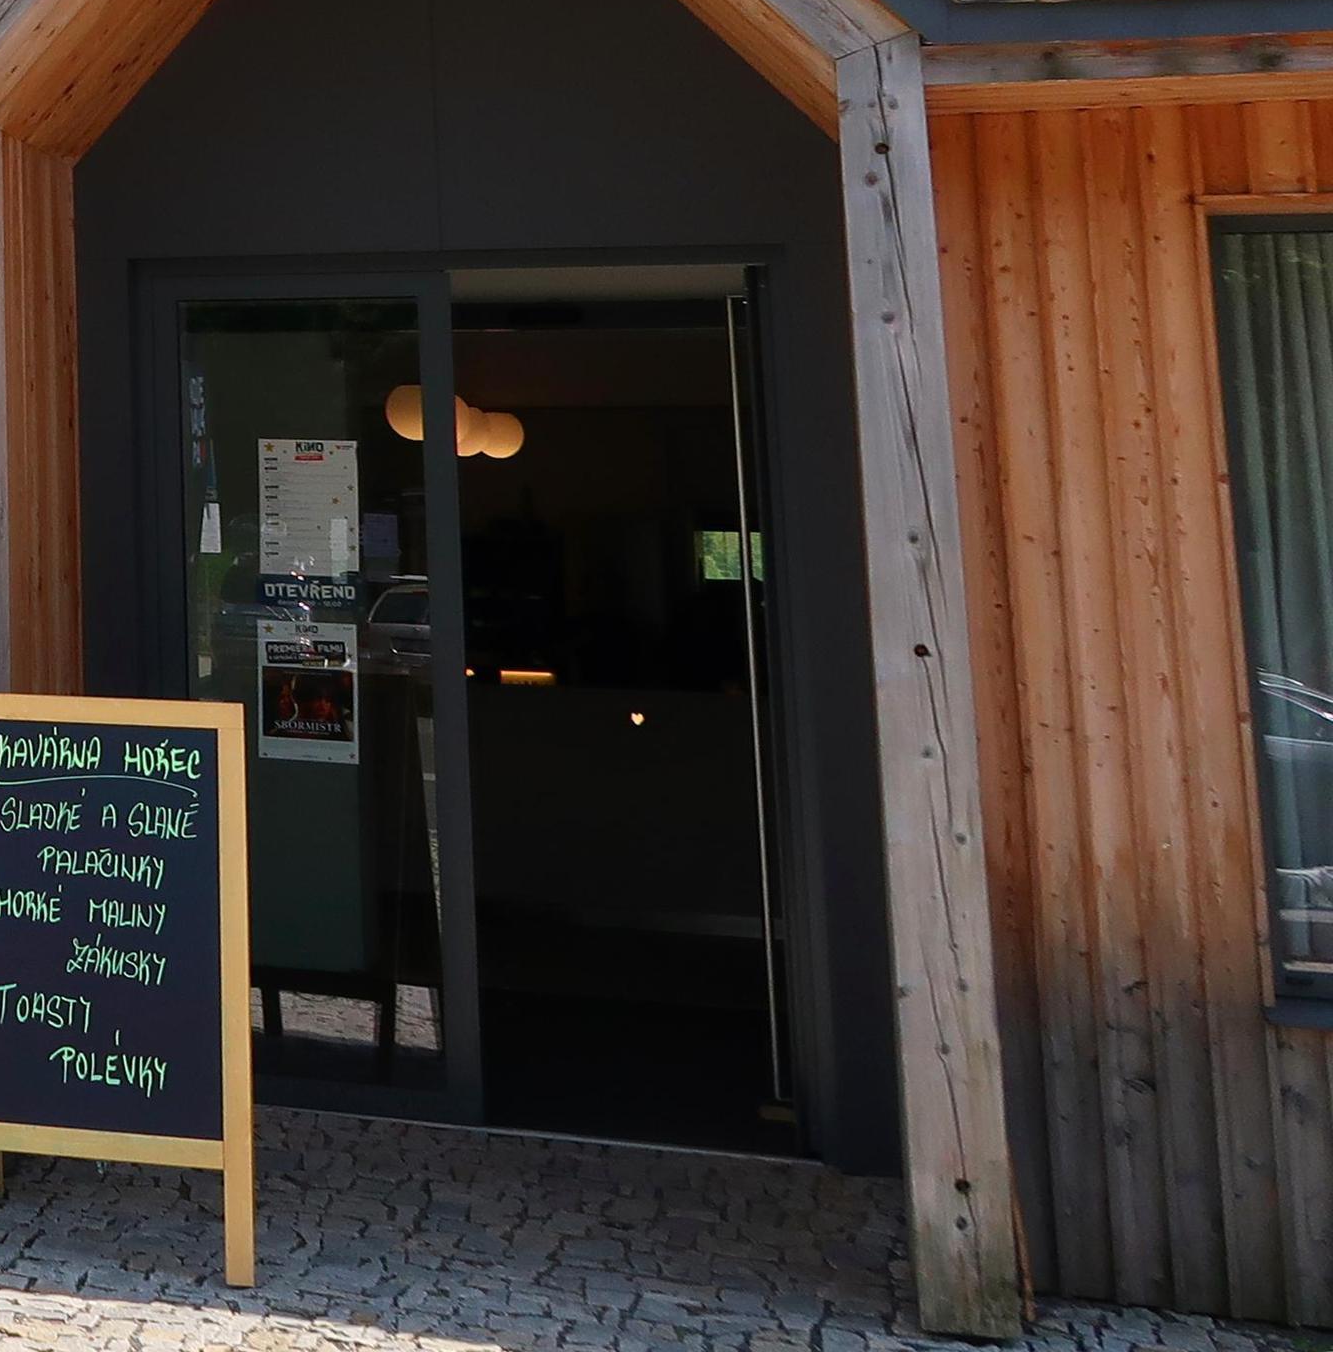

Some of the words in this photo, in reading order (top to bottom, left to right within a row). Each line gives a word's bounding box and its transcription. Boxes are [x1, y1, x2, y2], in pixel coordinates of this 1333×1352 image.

[263, 580, 355, 600] OTEVŘENO
[124, 739, 202, 780] HOŘEC
[0, 787, 86, 835] SLADKÉ
[101, 803, 117, 829] A
[37, 845, 164, 890] PALAČINKY
[89, 898, 166, 935] MALINY
[66, 933, 166, 985] ZÁKUSKY
[49, 1029, 167, 1098] POLÉVKY
